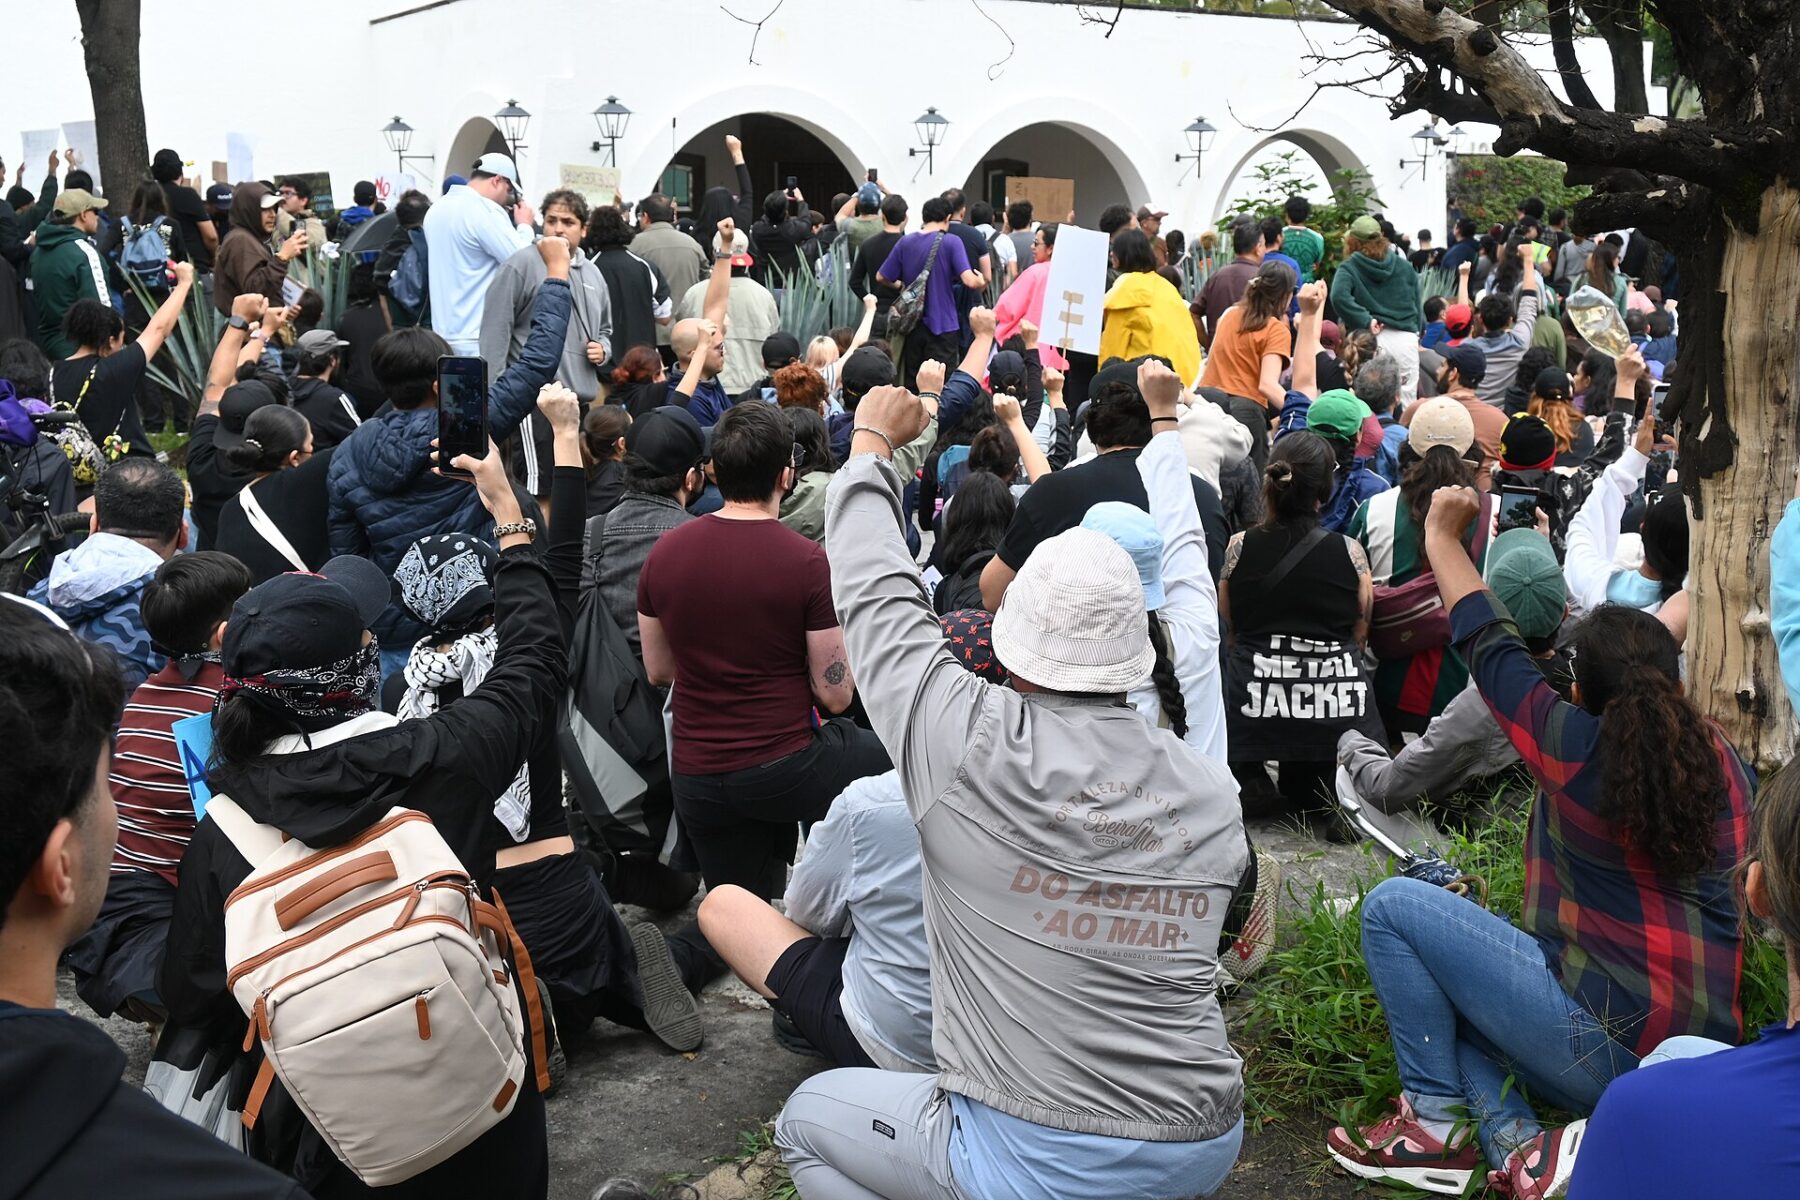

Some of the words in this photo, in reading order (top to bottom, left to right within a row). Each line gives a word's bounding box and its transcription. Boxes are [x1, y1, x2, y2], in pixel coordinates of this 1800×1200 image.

[375, 176, 390, 197] NO
[1253, 652, 1358, 678] METAL
[1240, 681, 1368, 719] JACKET
[1046, 781, 1129, 832] FORTALEZA
[1134, 785, 1193, 851] DIVISION
[1083, 811, 1141, 838] Beira
[1121, 817, 1166, 852] Mar
[1009, 864, 1070, 901] DO
[1074, 880, 1210, 920] ASFALTO
[1041, 909, 1098, 941] AO
[1106, 917, 1181, 950] MAR
[1123, 951, 1146, 960] ONDAS
